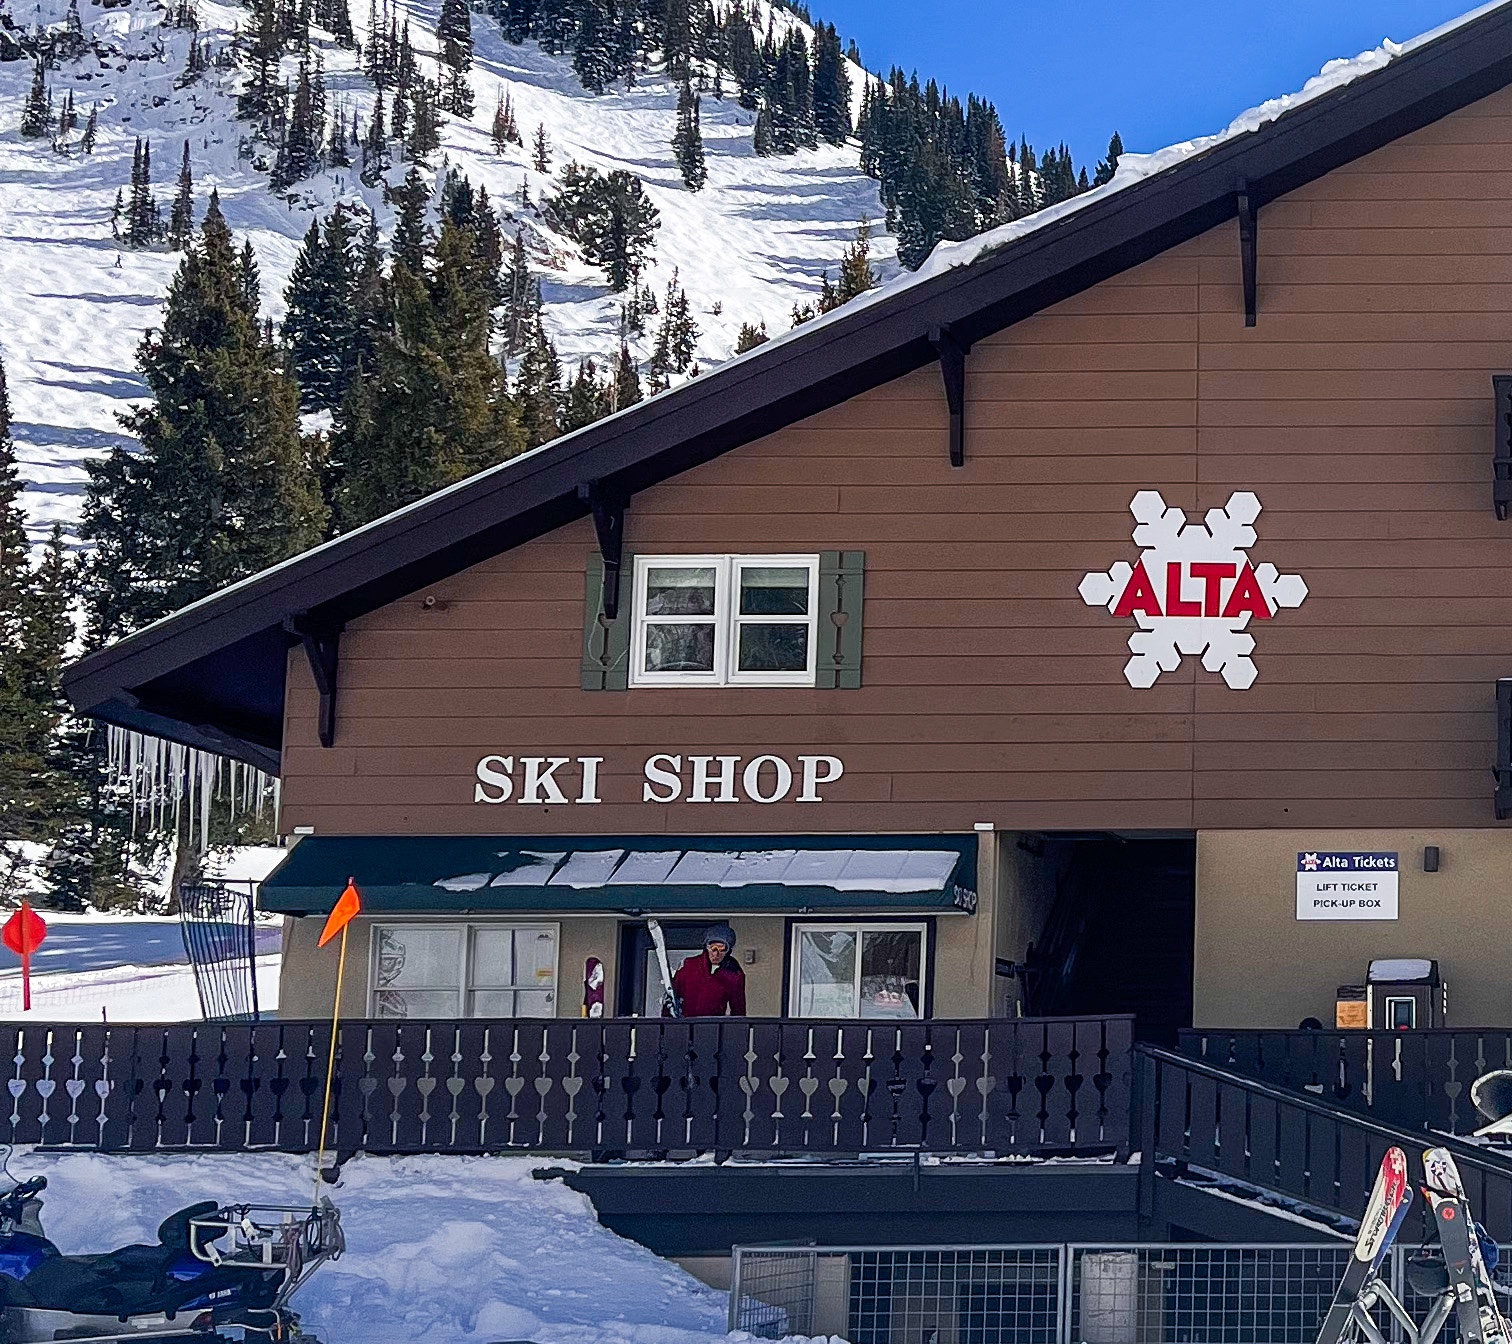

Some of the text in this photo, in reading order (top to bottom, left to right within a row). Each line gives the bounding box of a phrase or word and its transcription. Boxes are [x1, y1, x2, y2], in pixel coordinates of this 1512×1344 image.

[1113, 560, 1273, 619] ALTA
[474, 754, 844, 804] SKI SHOP
[1323, 856, 1395, 868] Alta Tickets
[1316, 883, 1378, 892] LIFT TICKET
[1313, 899, 1381, 908] PICK-UP BOX
